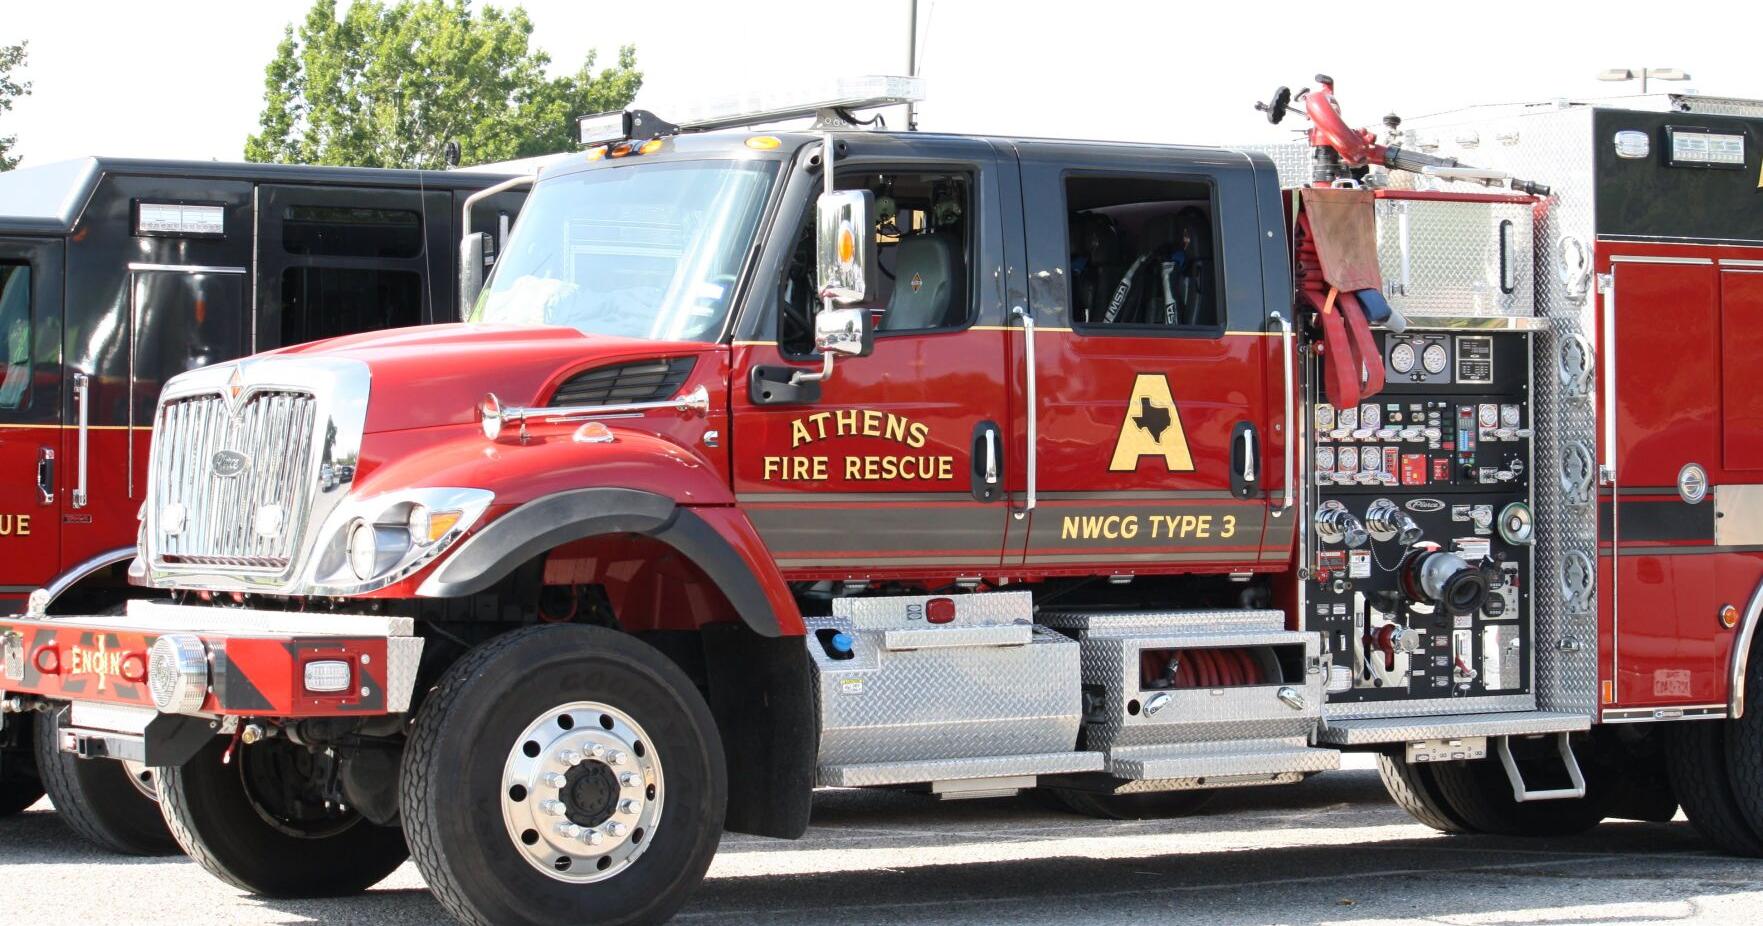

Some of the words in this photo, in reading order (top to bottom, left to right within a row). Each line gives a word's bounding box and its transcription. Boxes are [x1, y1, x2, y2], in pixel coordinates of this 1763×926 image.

[1108, 285, 1128, 314] MSA
[791, 409, 929, 448] ATHENS
[1109, 374, 1195, 471] A
[764, 456, 828, 480] FIRE
[845, 456, 954, 480] RESCUE
[1061, 515, 1139, 540] NWCG
[1149, 515, 1213, 539] TYPE
[1220, 514, 1236, 539] 3
[72, 646, 132, 677] ENGIN
